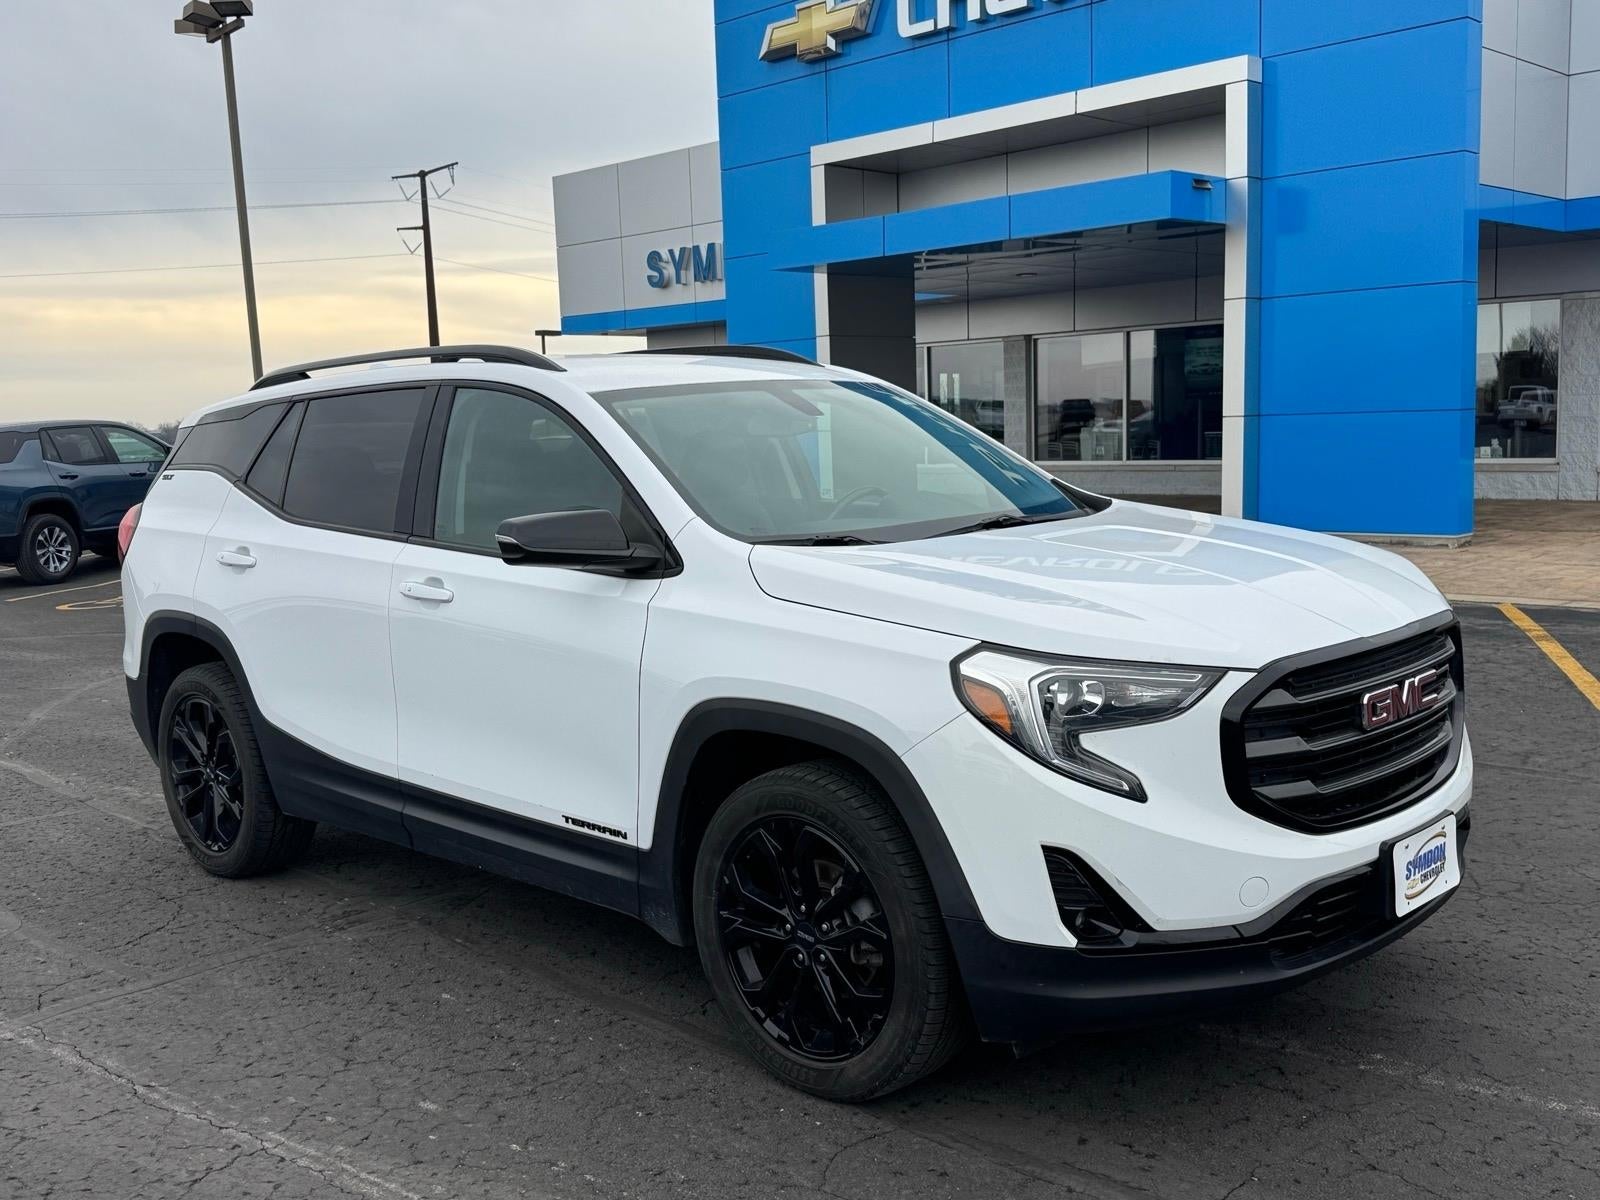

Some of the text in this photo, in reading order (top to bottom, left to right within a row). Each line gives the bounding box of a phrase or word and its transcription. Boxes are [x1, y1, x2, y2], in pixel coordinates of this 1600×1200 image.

[1362, 669, 1439, 730] GMC
[561, 814, 628, 840] TERRAIN
[1405, 841, 1446, 881] SYMDON
[1420, 862, 1446, 884] CHEVROLET
